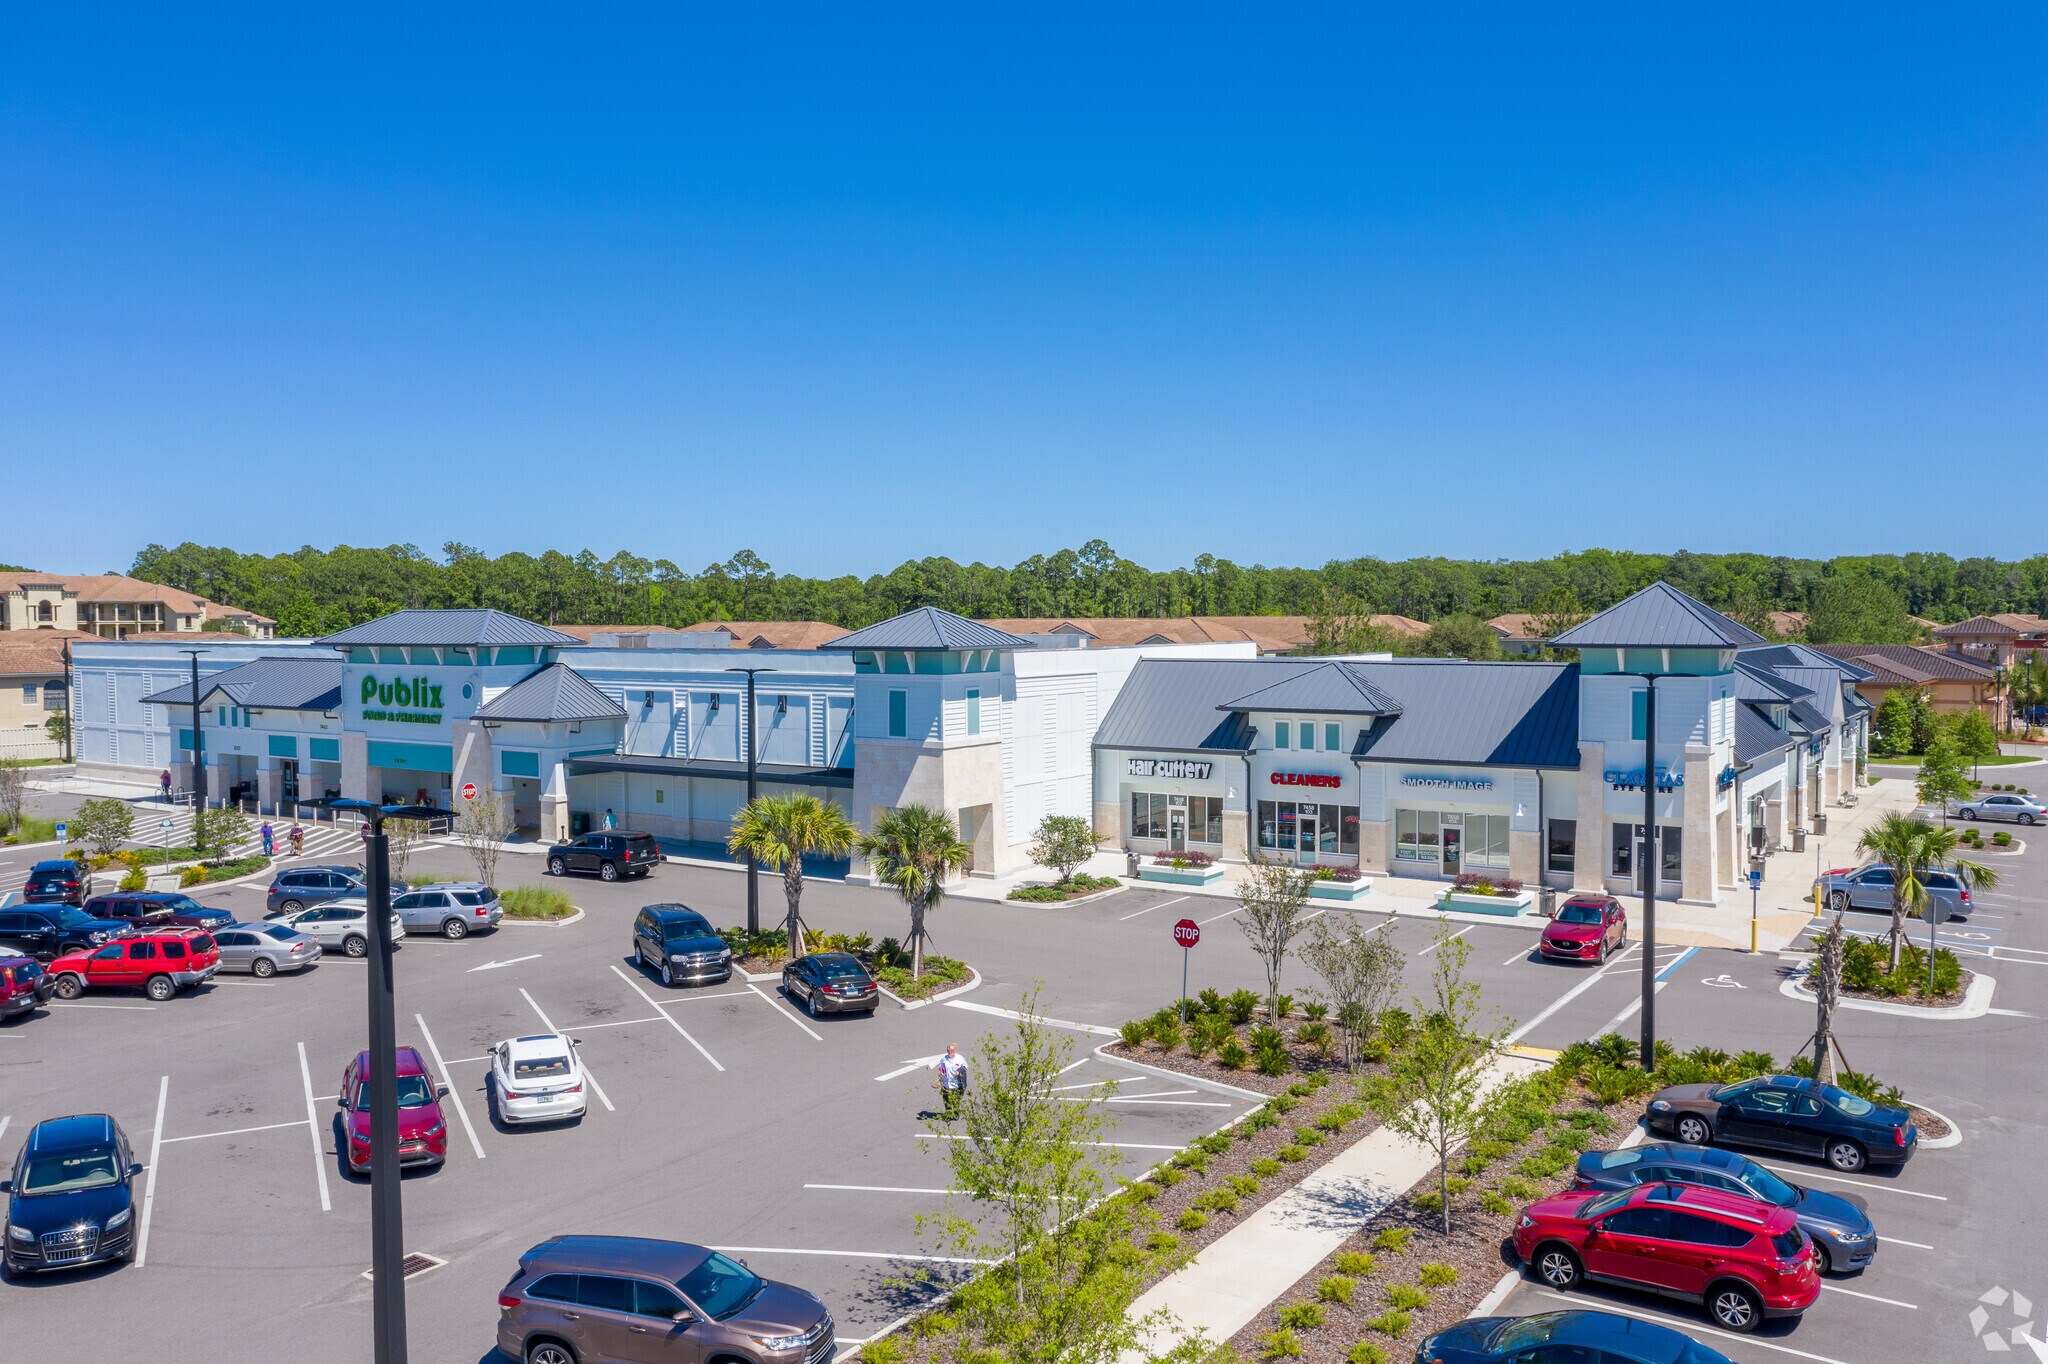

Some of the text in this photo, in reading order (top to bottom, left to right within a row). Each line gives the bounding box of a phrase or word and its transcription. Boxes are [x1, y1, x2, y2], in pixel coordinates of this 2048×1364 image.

[361, 675, 442, 708] Publix
[395, 713, 442, 725] PHARMACY
[1127, 759, 1155, 776] Hair
[1270, 772, 1341, 789] CLEANERS
[1400, 777, 1493, 791] SMOOTH IMAGE
[1603, 769, 1684, 787] CLARTAS
[1613, 783, 1674, 794] EYE CRE
[1175, 926, 1199, 940] STOP
